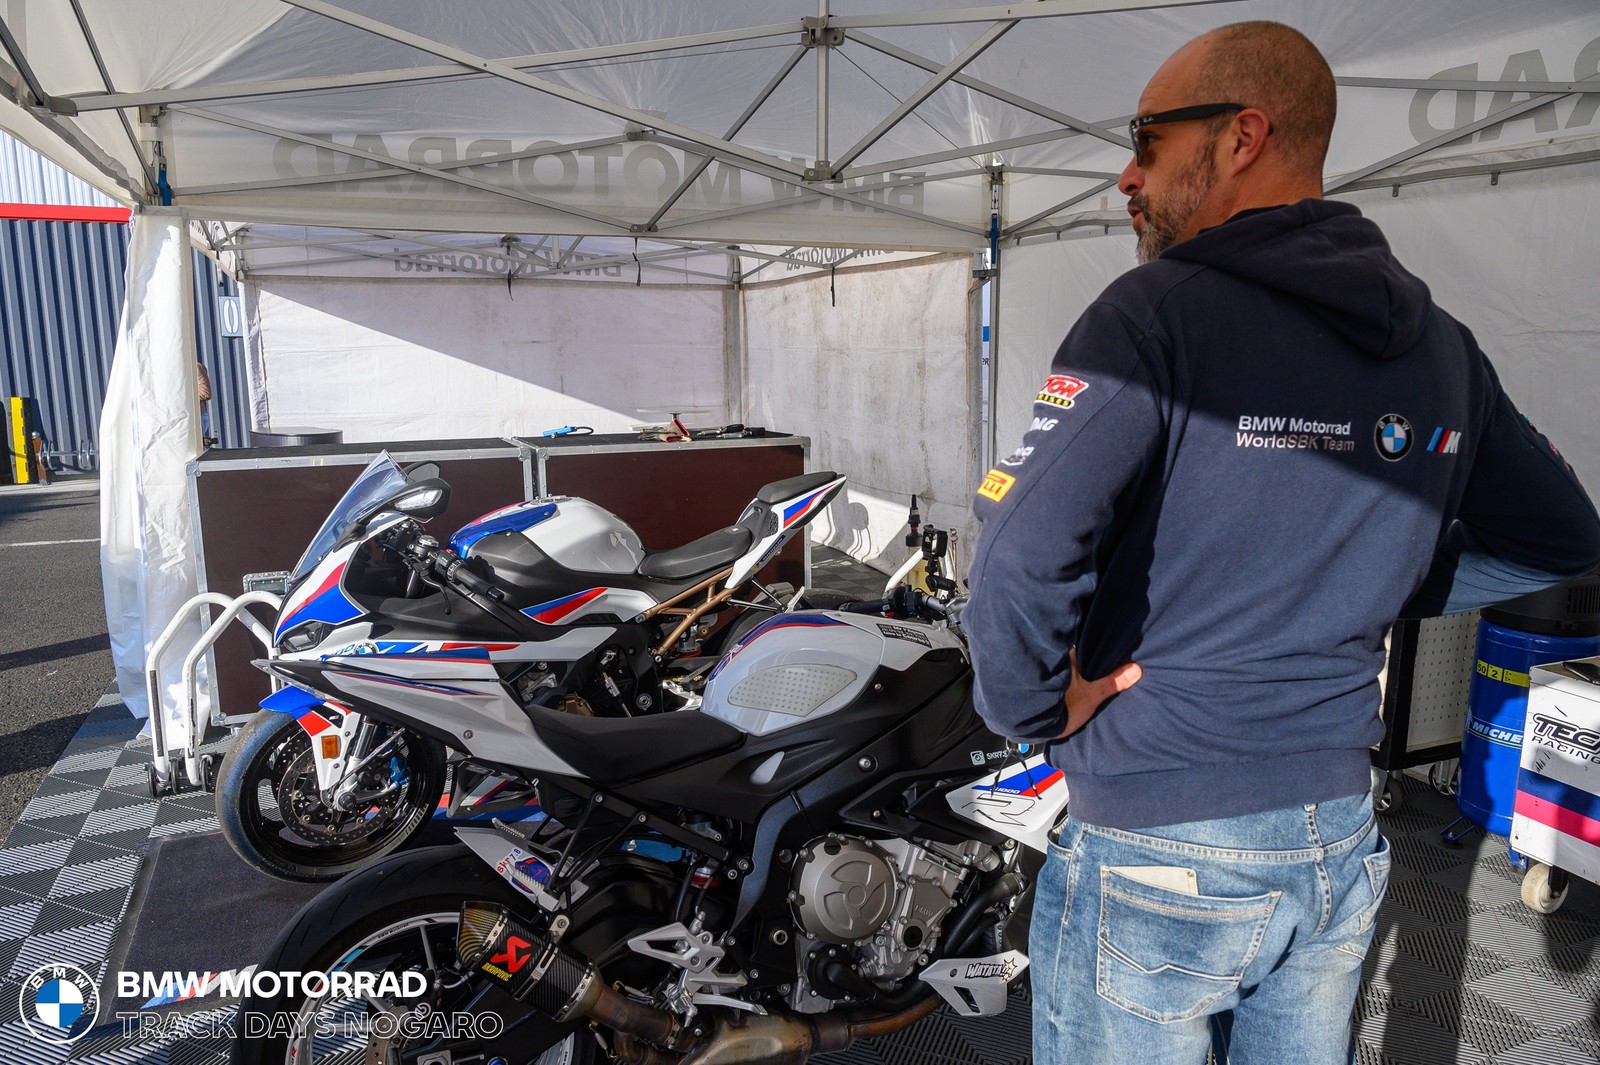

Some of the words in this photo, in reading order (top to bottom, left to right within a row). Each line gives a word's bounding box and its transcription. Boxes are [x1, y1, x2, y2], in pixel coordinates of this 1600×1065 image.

[1238, 415, 1287, 432] BMW
[1289, 417, 1352, 436] Motorrad
[1236, 431, 1318, 450] WorldSBK
[1322, 436, 1355, 451] Team
[1491, 669, 1498, 679] 2
[1472, 721, 1523, 744] MICHE
[1532, 735, 1600, 765] RACING
